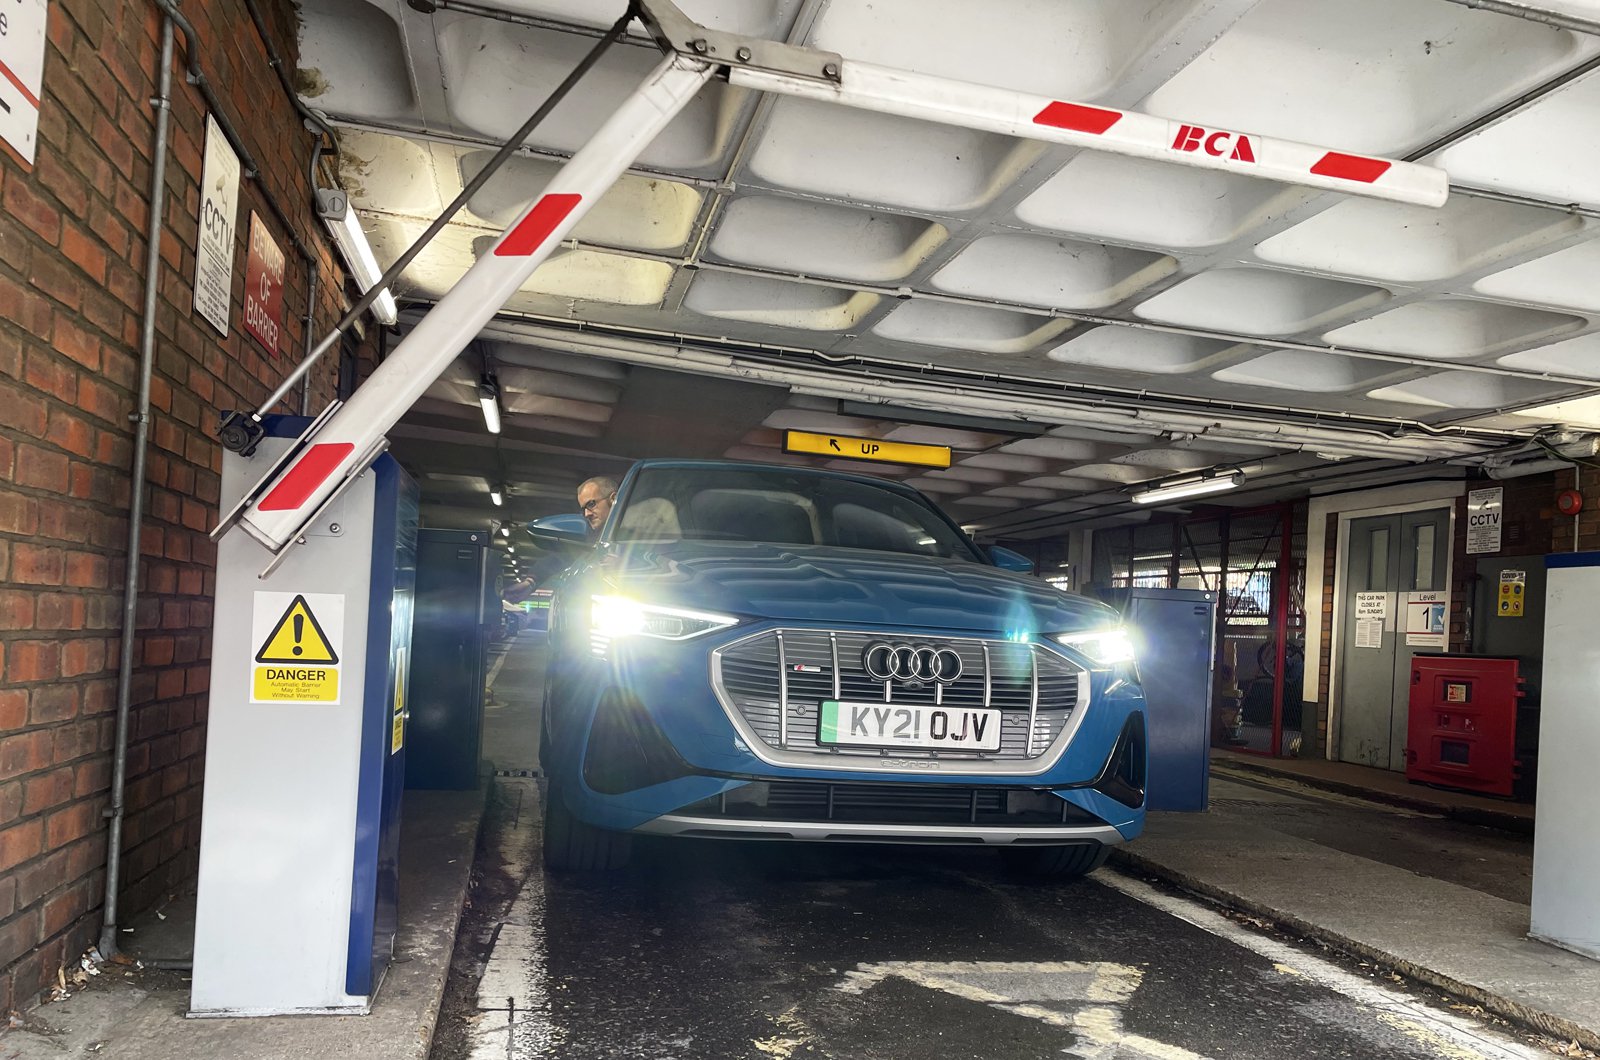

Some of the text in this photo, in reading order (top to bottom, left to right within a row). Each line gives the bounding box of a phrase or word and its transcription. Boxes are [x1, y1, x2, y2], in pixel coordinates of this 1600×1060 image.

[1171, 124, 1256, 164] BCA
[205, 197, 233, 255] CCTV
[253, 221, 282, 287] BEWARE
[260, 271, 272, 305] OF
[247, 294, 279, 353] BARRIER
[861, 443, 880, 455] UP
[1470, 513, 1500, 526] CCTV
[1419, 593, 1436, 601] Level
[1422, 606, 1430, 630] 1
[266, 669, 326, 681] DANGER
[850, 706, 988, 742] KY21 OJV
